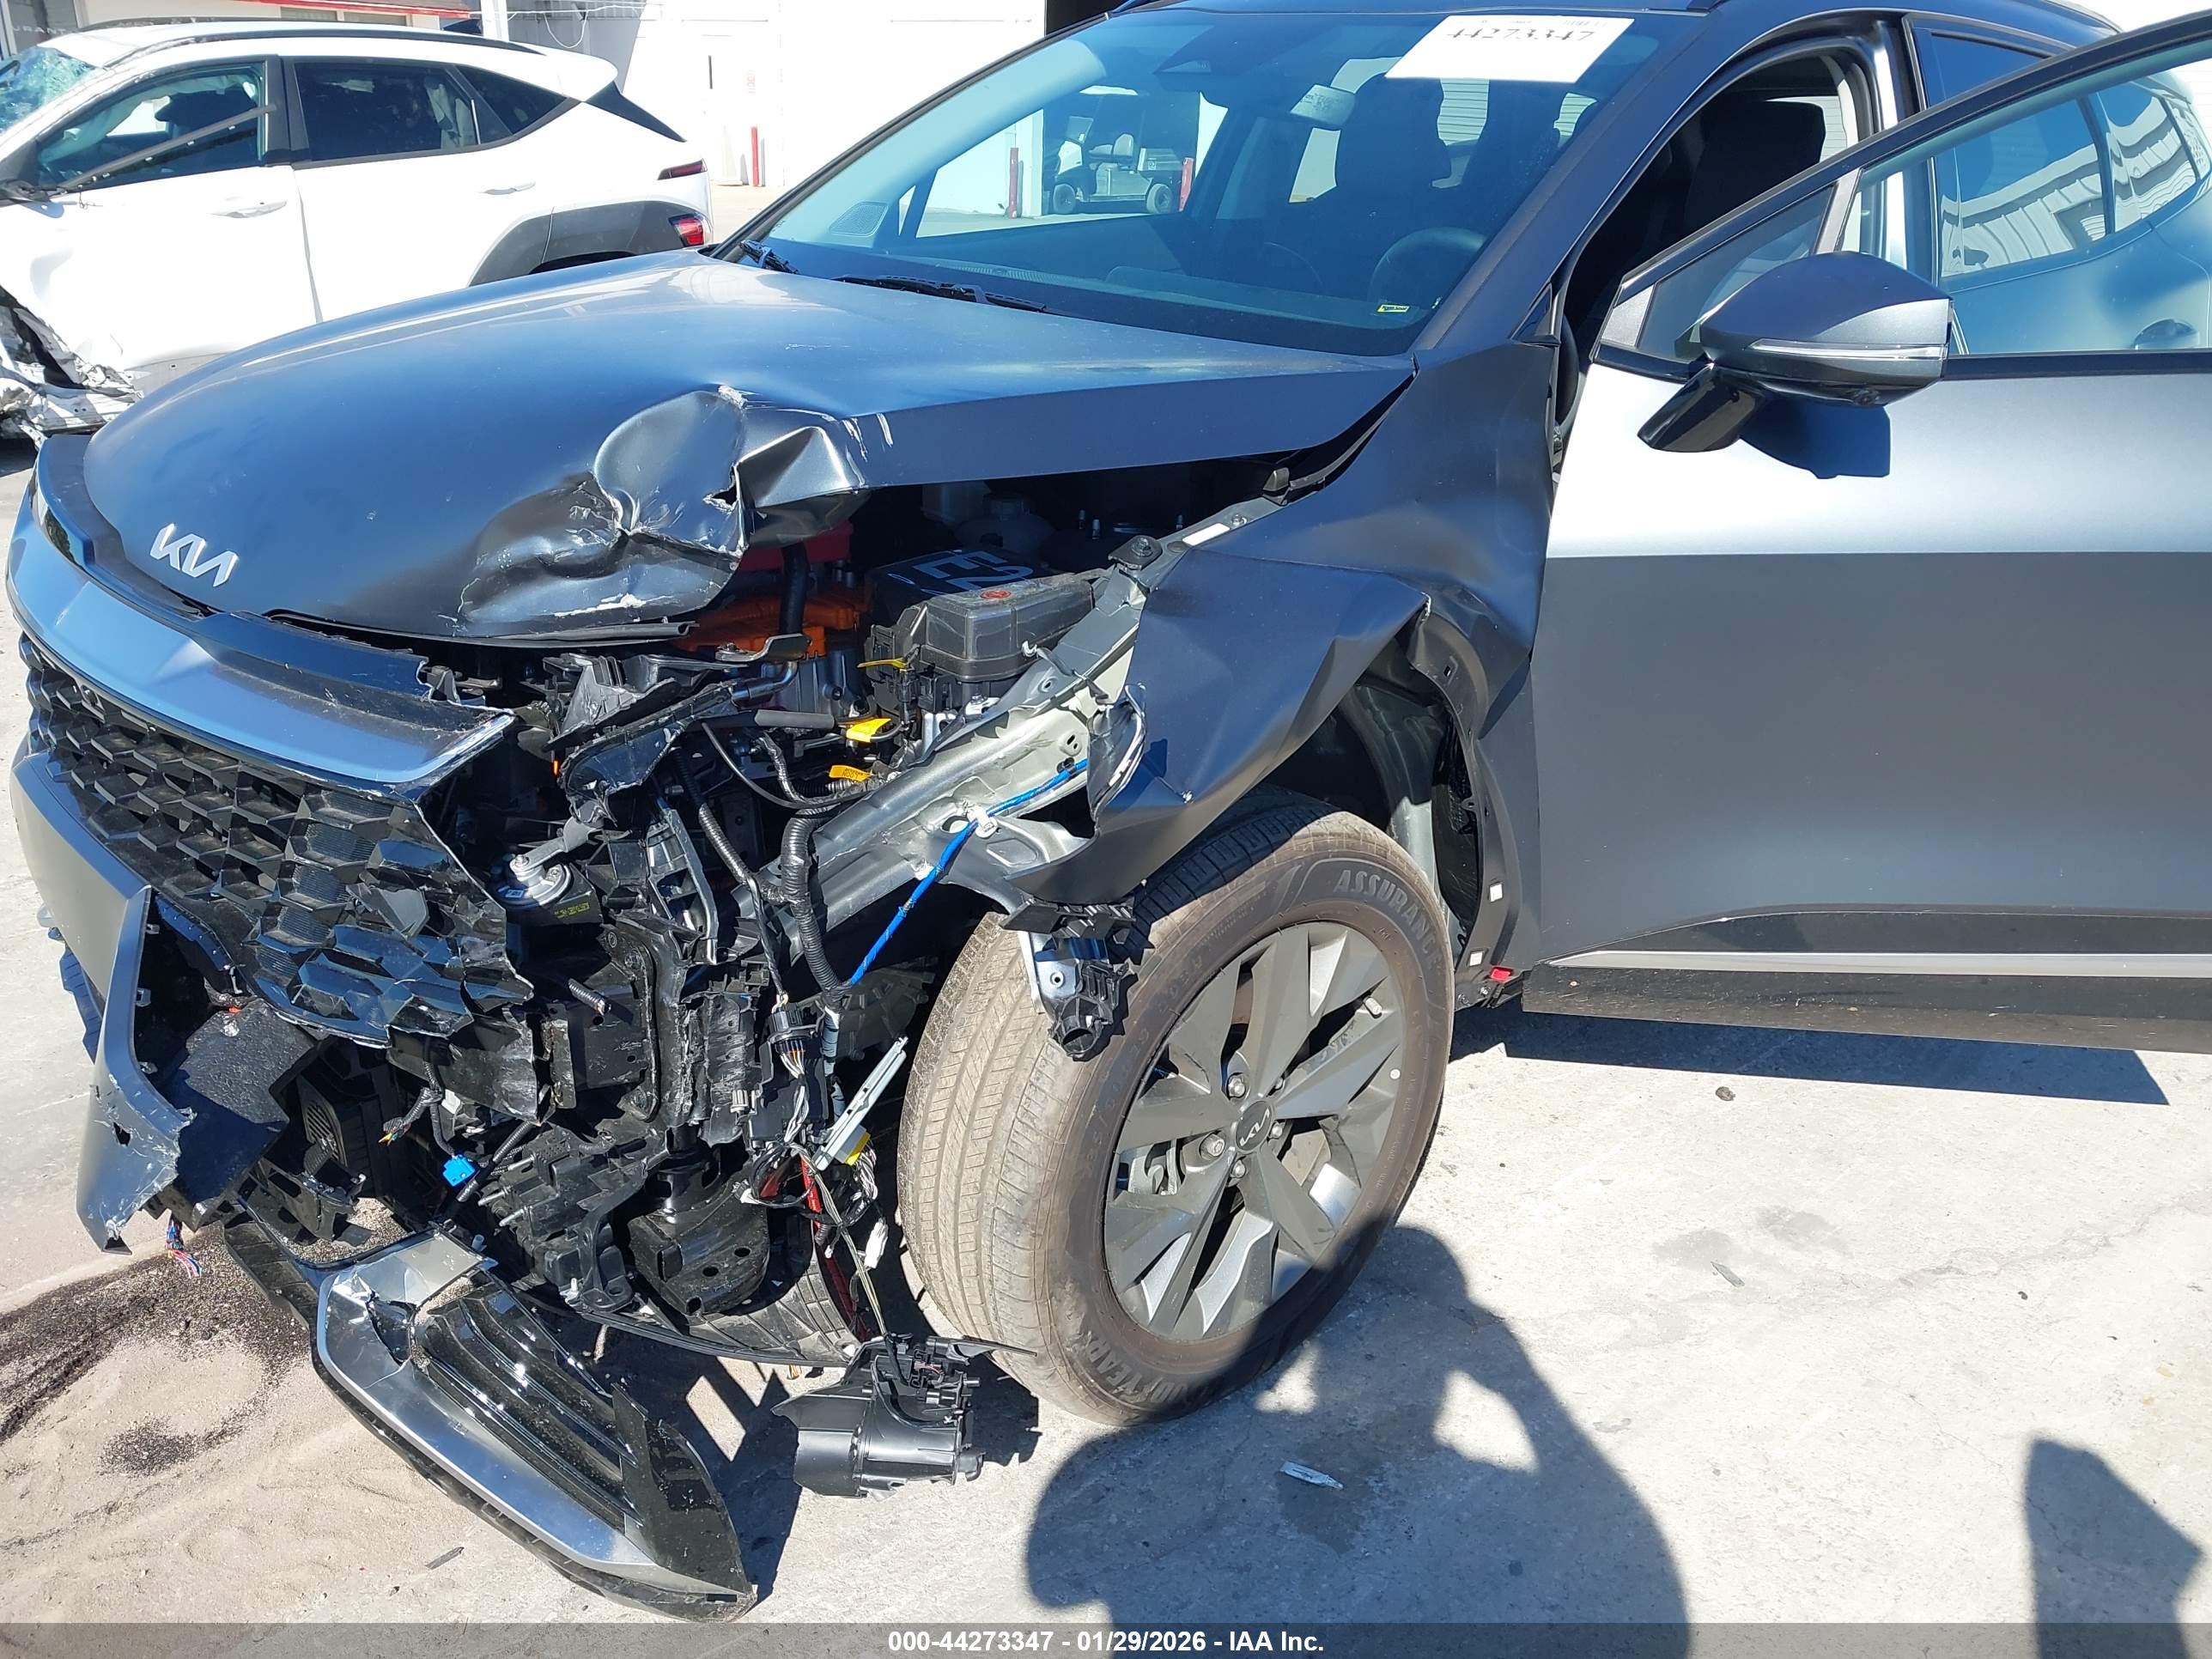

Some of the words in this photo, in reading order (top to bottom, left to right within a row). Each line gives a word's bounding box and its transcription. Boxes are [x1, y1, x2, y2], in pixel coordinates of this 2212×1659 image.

[1447, 28, 1595, 40] 44273347
[150, 523, 240, 587] KIA
[1333, 869, 1442, 964] ASSURANCE
